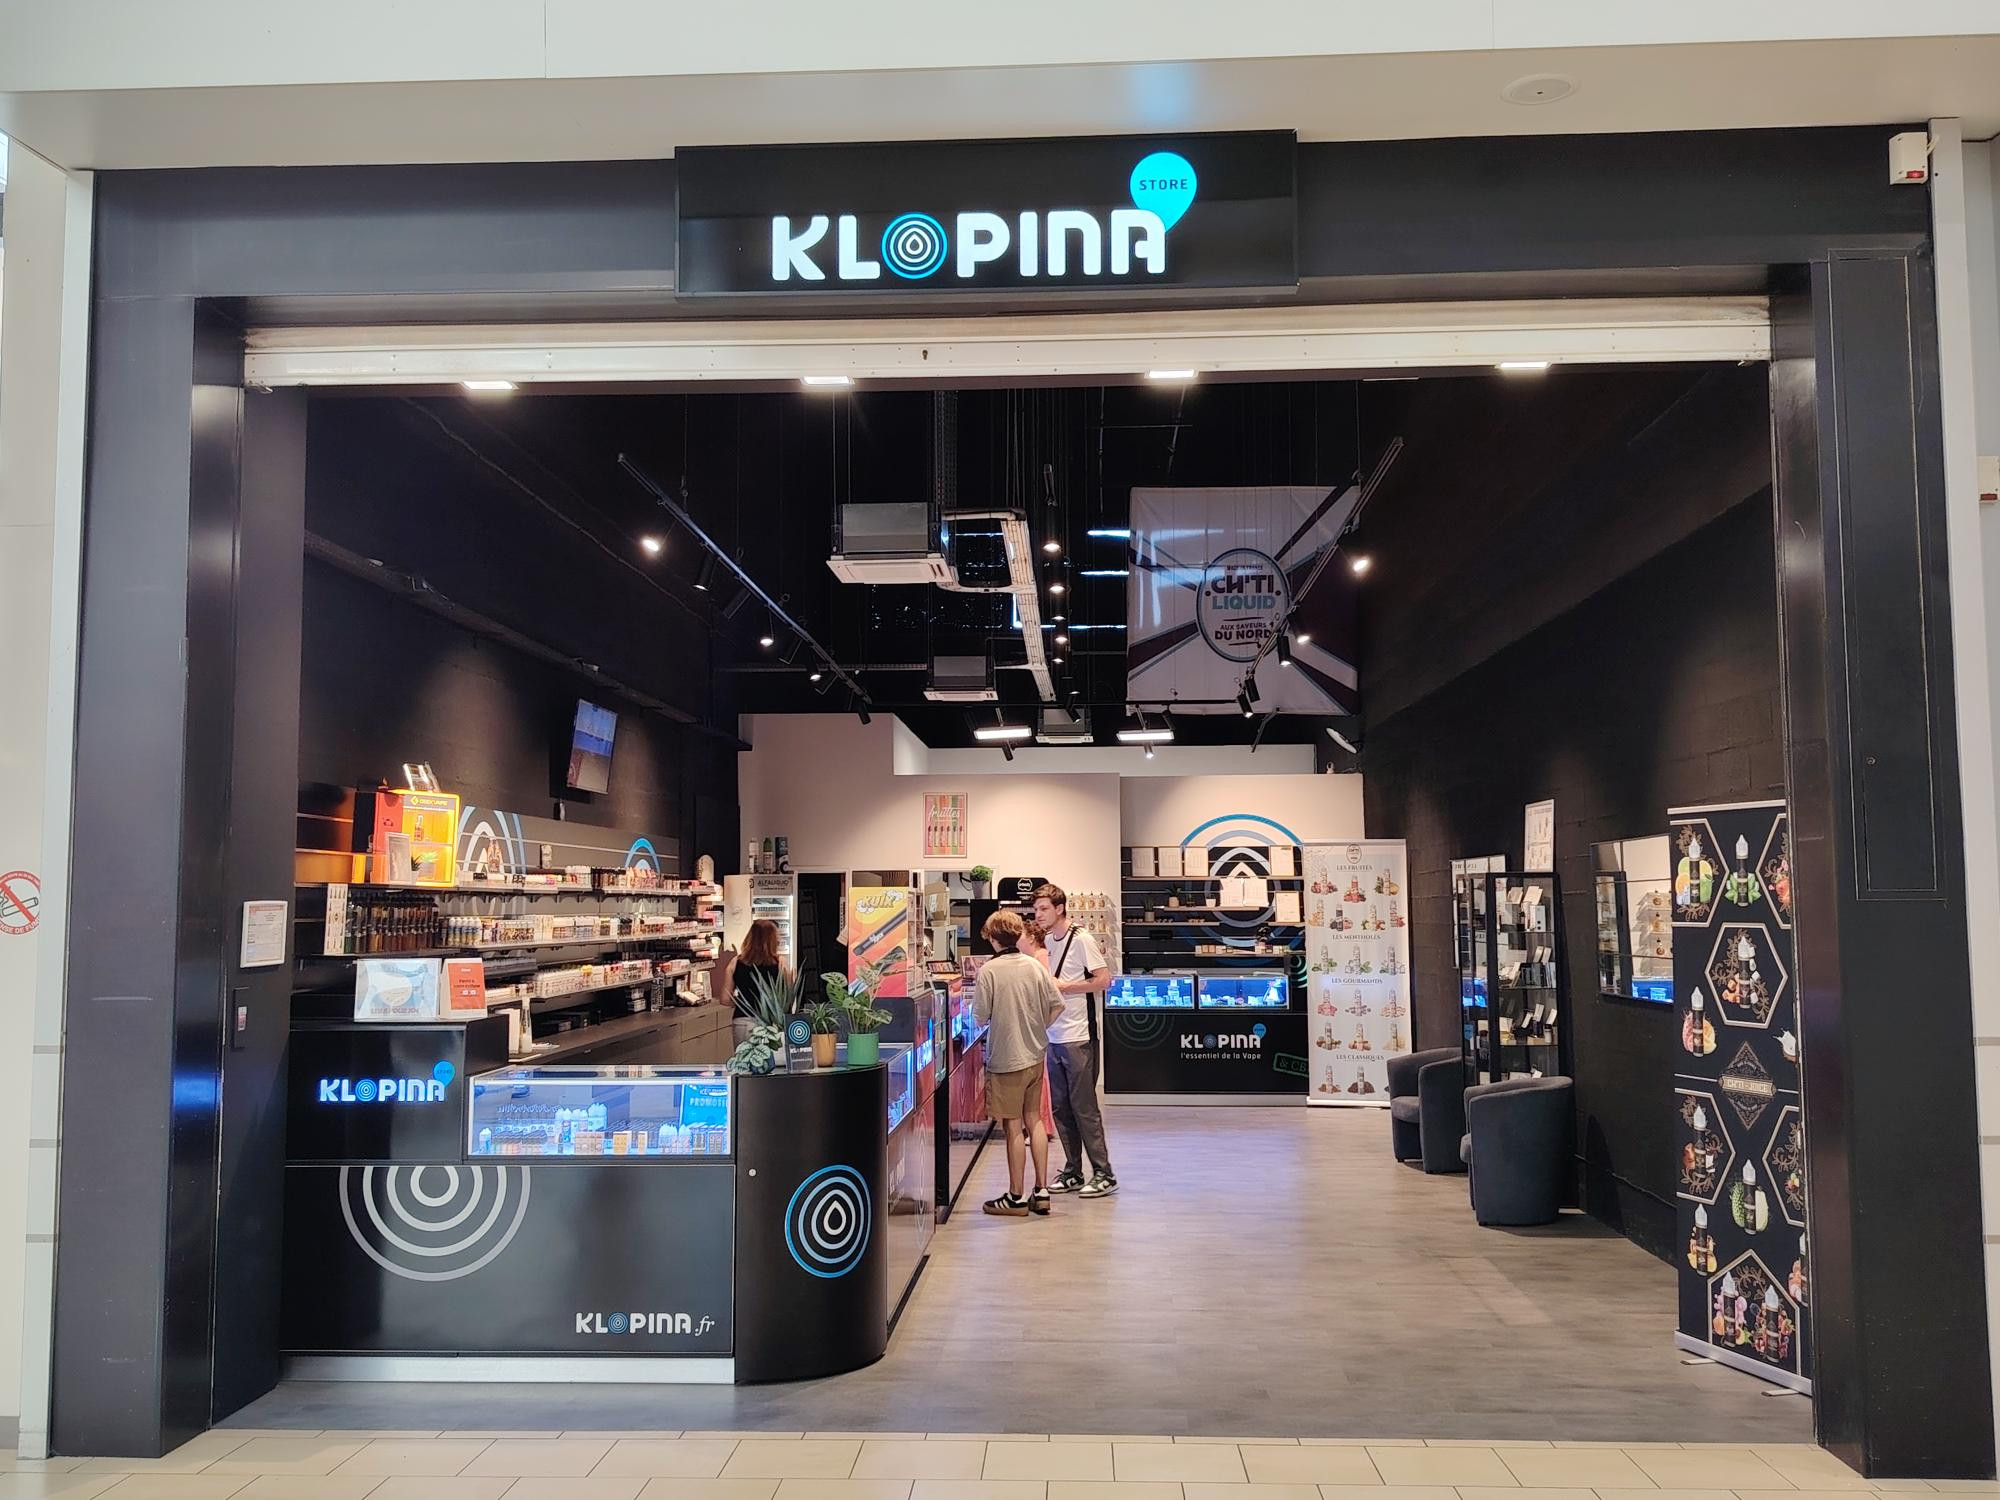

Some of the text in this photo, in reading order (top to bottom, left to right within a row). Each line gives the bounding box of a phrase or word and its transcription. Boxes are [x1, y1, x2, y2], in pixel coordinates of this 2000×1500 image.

[1139, 178, 1189, 192] STORE
[771, 208, 1167, 282] KLOPINA
[1211, 574, 1274, 594] CH'TI
[1212, 595, 1276, 610] LIQUID
[1236, 622, 1267, 630] SAVEURS
[1215, 629, 1272, 640] DU NORD
[1180, 1034, 1261, 1049] KLOPINA
[1180, 1052, 1220, 1060] l'essentiel
[1242, 1052, 1262, 1061] Vape
[319, 1079, 445, 1102] KLOPINA
[689, 1097, 727, 1108] PROMOTI
